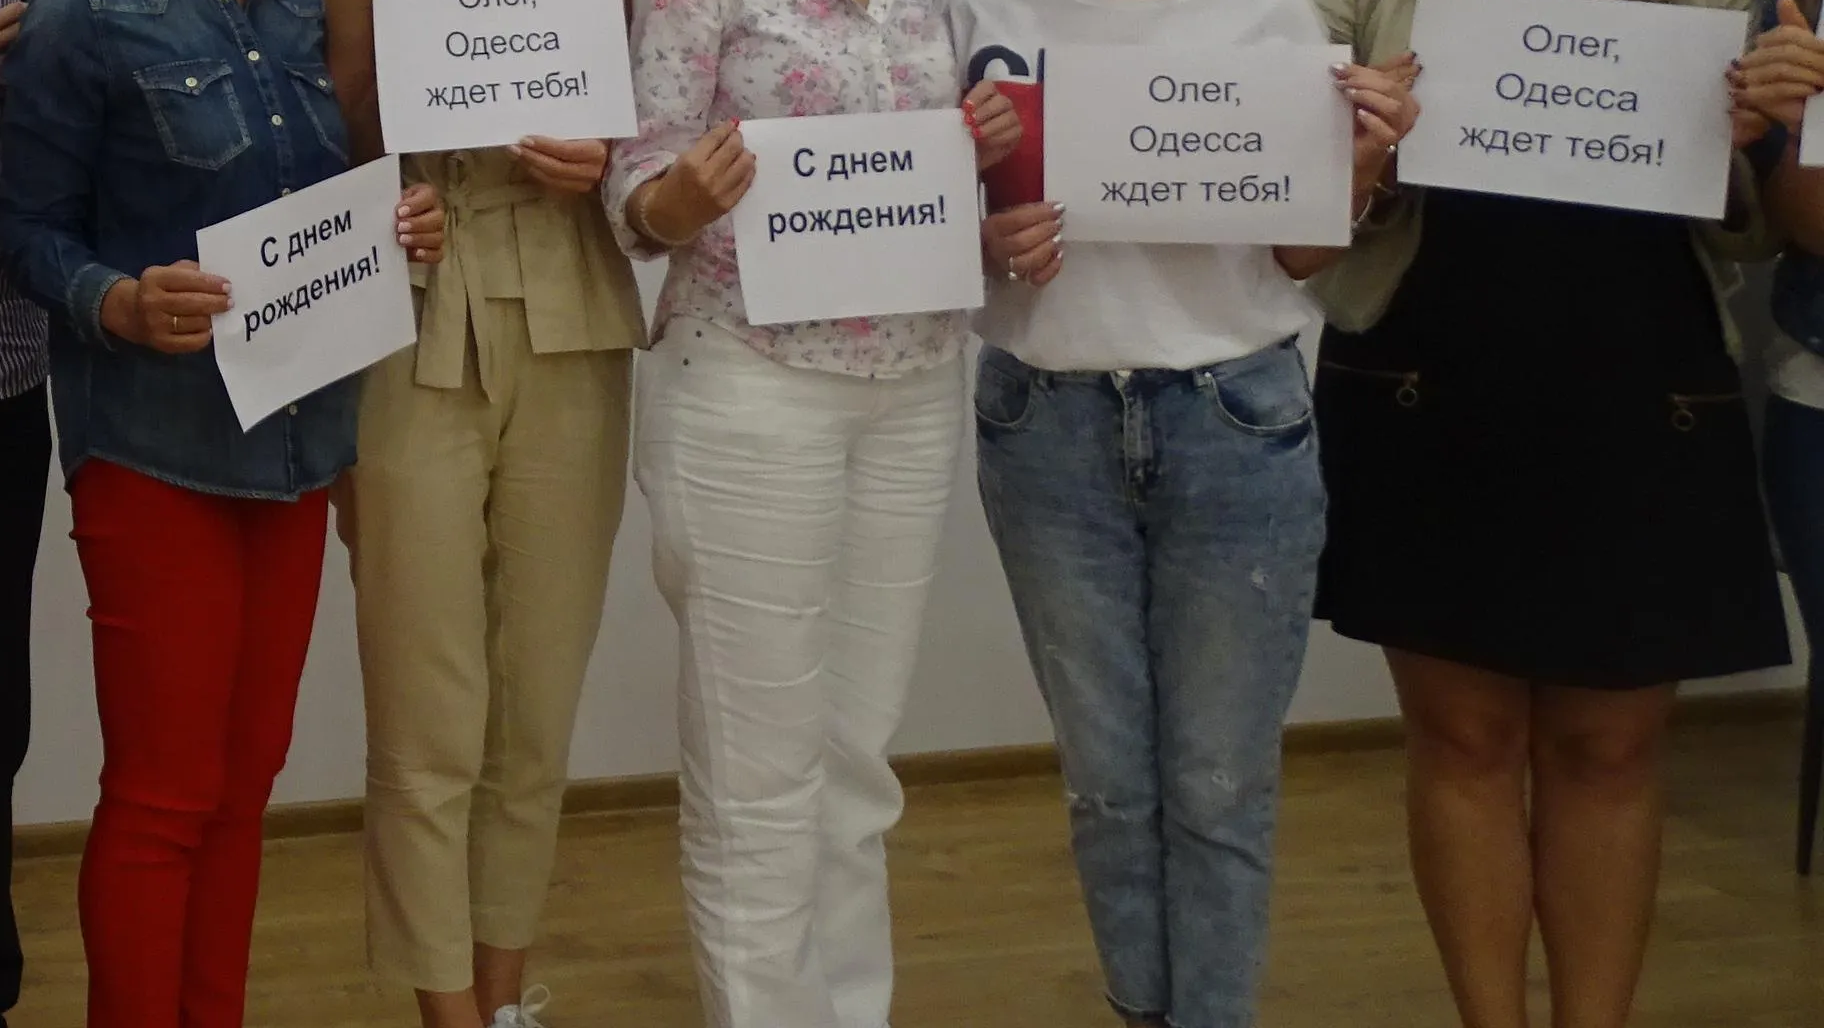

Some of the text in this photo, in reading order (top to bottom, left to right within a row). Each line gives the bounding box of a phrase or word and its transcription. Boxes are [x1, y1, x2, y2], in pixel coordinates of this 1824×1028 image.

[445, 31, 560, 61] Одесса
[1522, 24, 1619, 63] Олег,
[425, 70, 588, 111] ждет тебя!
[1148, 75, 1241, 107] Олег,
[1495, 73, 1638, 113] Одесса
[1129, 125, 1263, 157] Одесса
[1458, 126, 1665, 167] ждет тебя!
[793, 147, 913, 181] С днем
[1101, 174, 1290, 207] ждет тебя!
[767, 194, 946, 243] рождения!
[260, 209, 352, 268] С днем
[243, 244, 380, 342] рождения!
